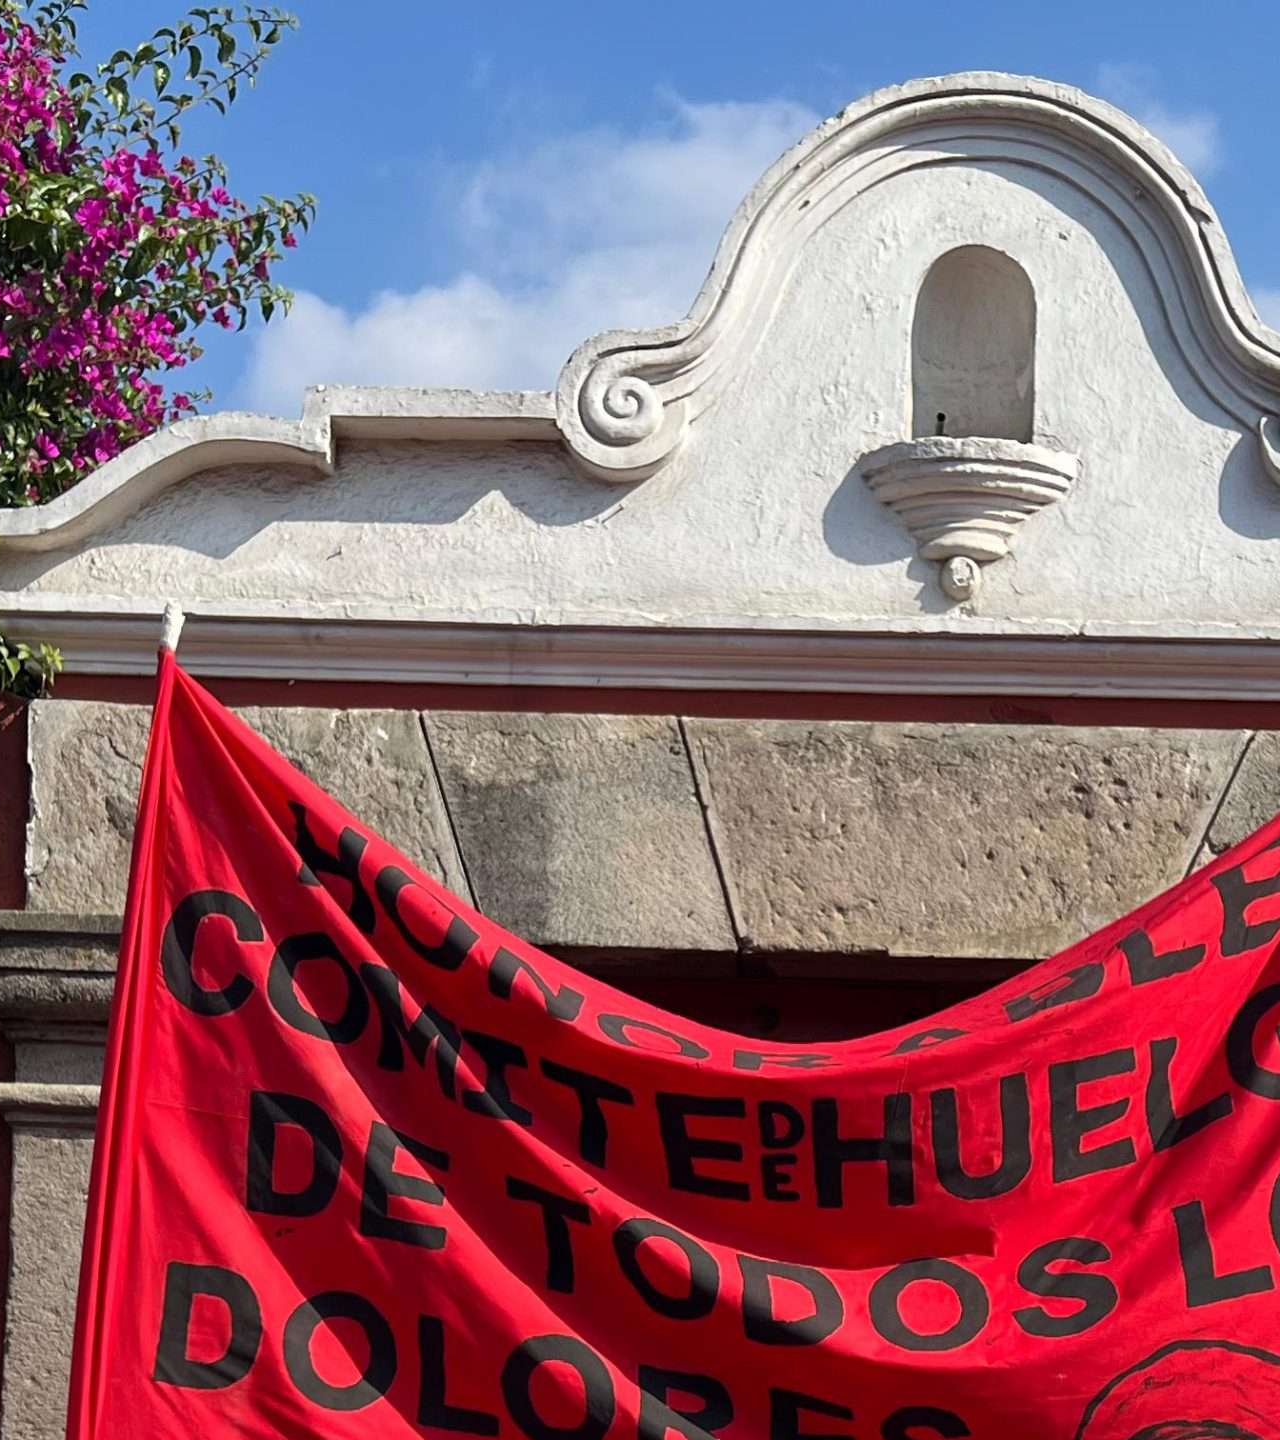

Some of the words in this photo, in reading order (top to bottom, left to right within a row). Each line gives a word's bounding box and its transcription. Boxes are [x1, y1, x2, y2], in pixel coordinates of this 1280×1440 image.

[161, 889, 750, 1201] COMITE
[760, 1101, 805, 1201] DE
[246, 1091, 449, 1250] DE
[506, 1177, 1119, 1351] TODOS
